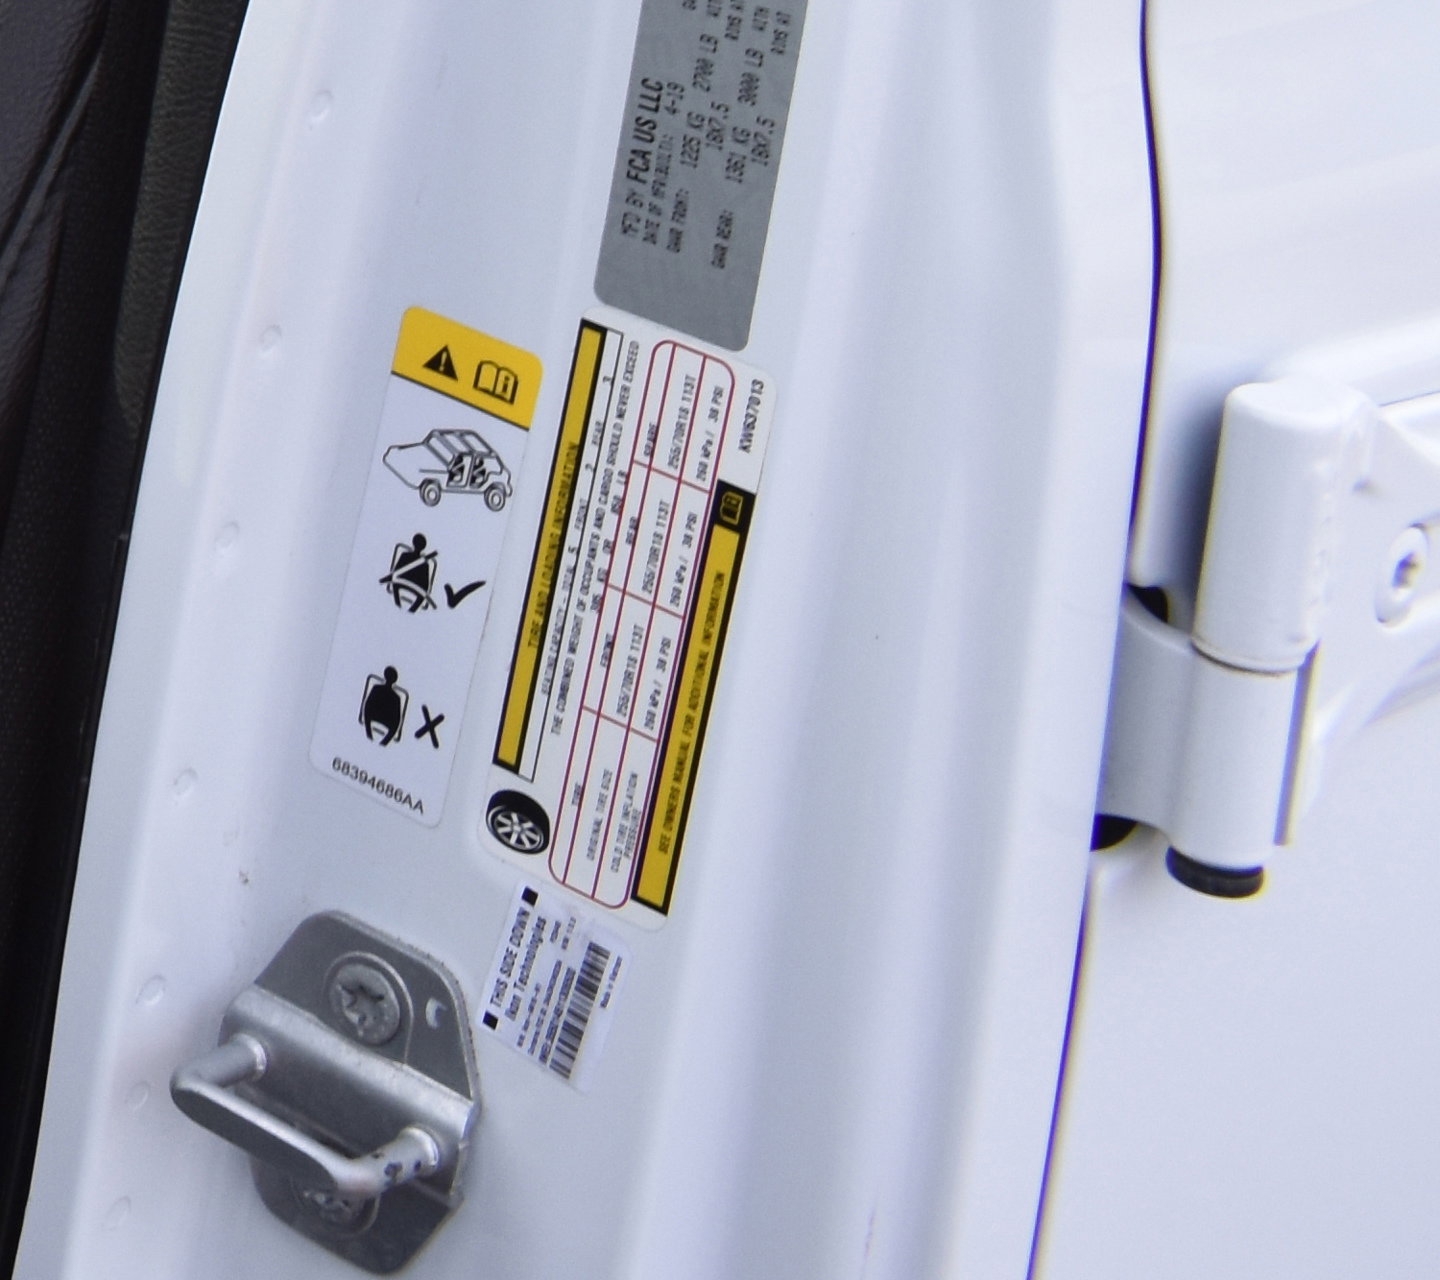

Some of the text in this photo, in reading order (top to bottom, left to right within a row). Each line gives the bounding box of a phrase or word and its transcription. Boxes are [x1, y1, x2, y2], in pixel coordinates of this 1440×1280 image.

[775, 10, 790, 26] AT
[699, 33, 718, 53] LB
[744, 47, 763, 68] LB
[770, 28, 788, 55] RIMS
[692, 57, 714, 92] 2700
[704, 100, 729, 151] 18X7.5
[724, 14, 741, 41] RIMS
[737, 72, 760, 107] 3000
[686, 111, 705, 131] KG
[732, 126, 751, 145] KG
[620, 77, 663, 235] MFD BY FCA US LLC
[679, 134, 701, 168] 1225
[750, 116, 775, 167] 18X7.5
[642, 81, 684, 245] DATE OF 4-19
[724, 152, 746, 184] 1361
[671, 188, 689, 224] FRONT:
[716, 210, 733, 241] REAR:
[712, 386, 724, 406] PSI
[708, 407, 720, 423] 38
[738, 378, 764, 453] KW637013
[696, 461, 709, 482] 260
[541, 376, 613, 695] SEATING CAPACITY TOTAL 5 FRONT 2 REAR 3
[550, 340, 639, 734] THE COMBINED WEIGHT OF OCCUPANTS AND CARGO SHOULD NEVER EXCEED
[596, 568, 607, 583] KG
[602, 538, 613, 555] OR
[617, 470, 628, 485] LB
[685, 512, 698, 532] PSI
[527, 442, 579, 649] TIRE AND LOADING INFORMATION
[682, 533, 694, 548] 38
[669, 586, 682, 607] 260
[571, 423, 658, 807] TIRE FRONT REAR SPARE
[586, 374, 696, 861] ORIGINAL TIRE SIZE 255/70R18 113T 255/70R18 113T 255/70R18 113T
[659, 637, 672, 656] PSI
[656, 657, 667, 673] 38
[644, 710, 656, 730] 260
[658, 572, 725, 854] SEE OWNERS MANUAL FOR ADDITIONAL INFORMATION
[332, 756, 423, 815] 68394686AA
[621, 772, 638, 820] INFLATION
[616, 823, 628, 843] TIRE
[623, 808, 641, 859] PRESSURE
[610, 846, 623, 873] COLD
[490, 907, 530, 1008] THIS SIDE DOWN
[513, 916, 547, 992] Technologies
